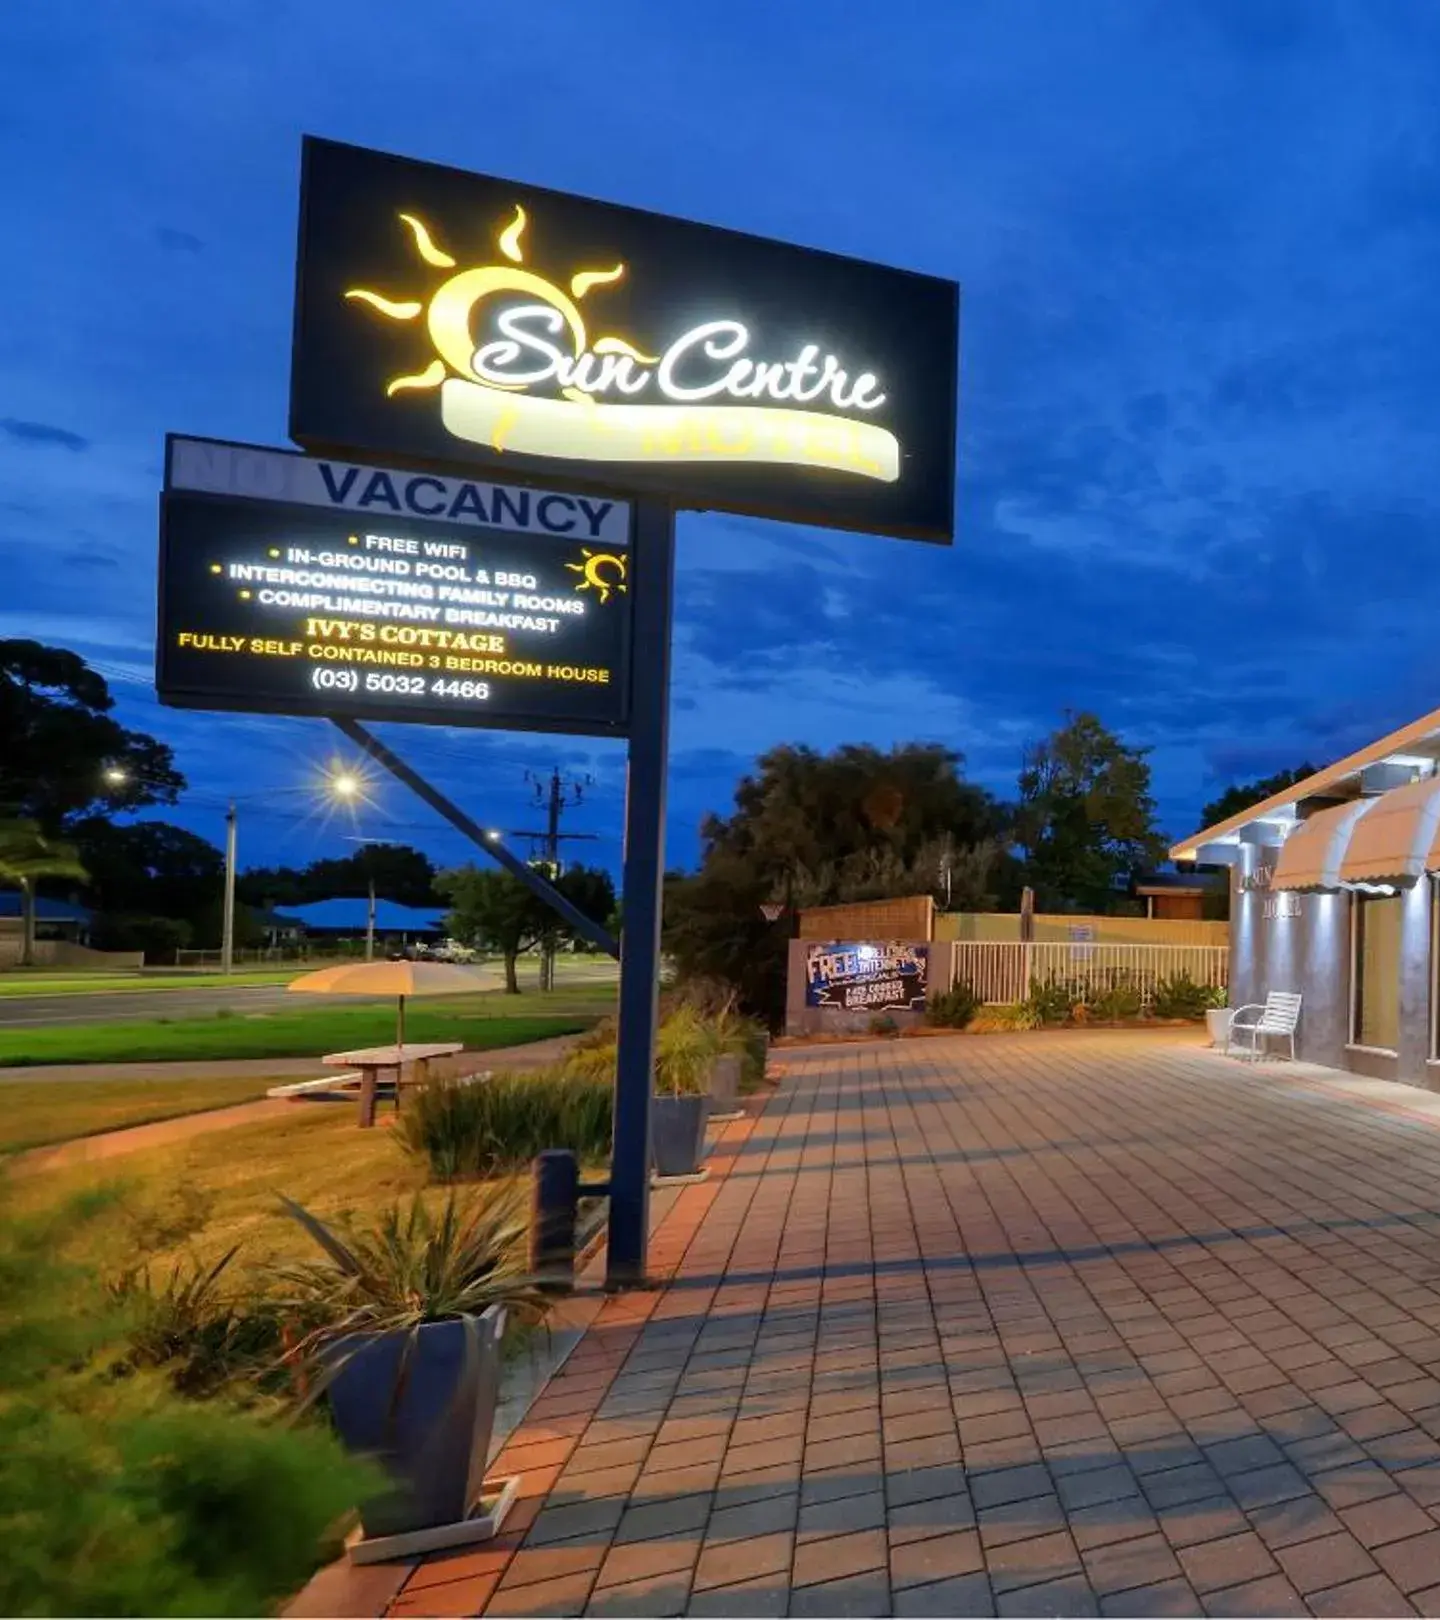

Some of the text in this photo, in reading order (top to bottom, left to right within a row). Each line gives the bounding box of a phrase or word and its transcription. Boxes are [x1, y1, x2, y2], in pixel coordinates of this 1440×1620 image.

[470, 305, 887, 410] Sun Centre
[317, 462, 614, 537] VACANCY
[287, 547, 537, 590] IN-GROUND POOL & BBQ
[365, 535, 467, 560] FREE WIFI
[229, 563, 585, 615] INTERCONNECTING FAMILY ROOMS
[258, 589, 560, 633] COMPLIMENTARY BREAKFAST
[306, 618, 505, 654] IVY'S COTTAGE
[177, 632, 610, 684] FULLY SELF CONTAINED 3 BEDROOM HOUSE
[312, 667, 489, 700] (03) 5032 4466
[807, 951, 858, 984] FREE
[845, 987, 906, 1007] BREAKFAST
